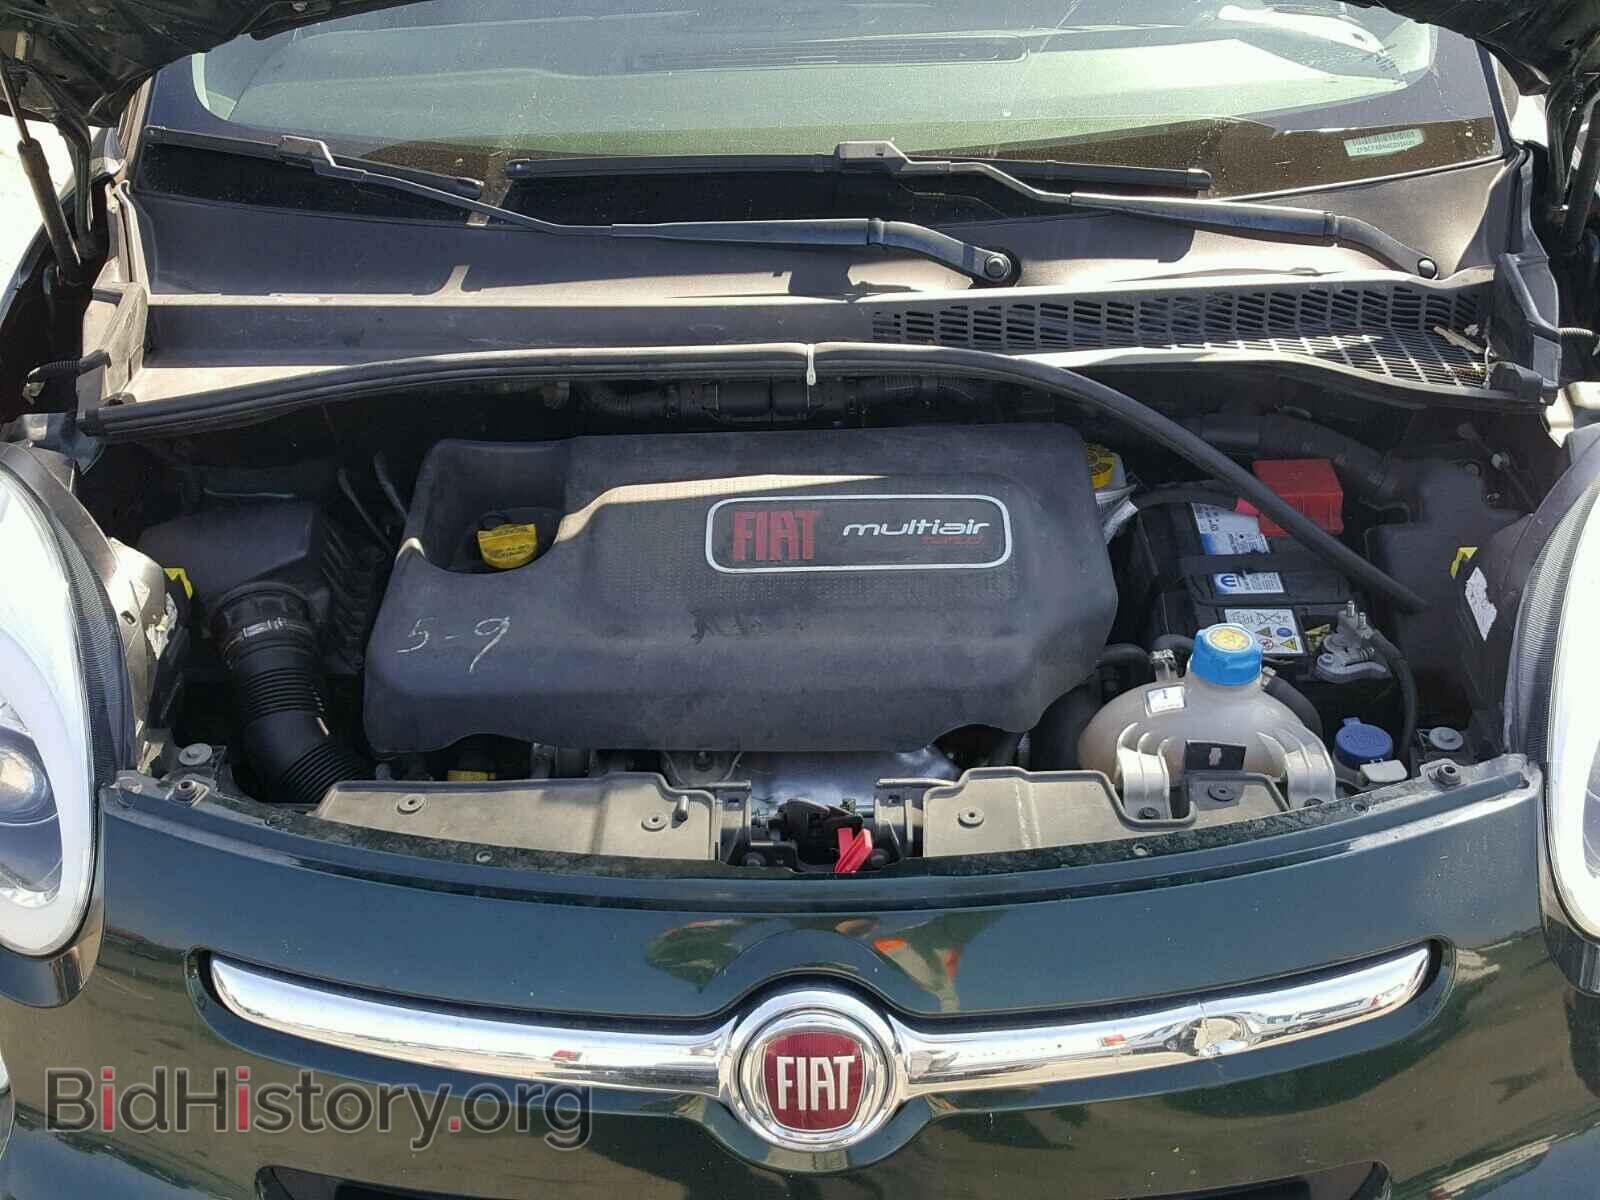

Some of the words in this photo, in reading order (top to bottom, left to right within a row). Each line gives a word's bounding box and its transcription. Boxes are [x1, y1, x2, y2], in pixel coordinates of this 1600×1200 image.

[732, 510, 818, 561] FIAT
[842, 518, 990, 537] multiair
[776, 1055, 855, 1112] FIAT
